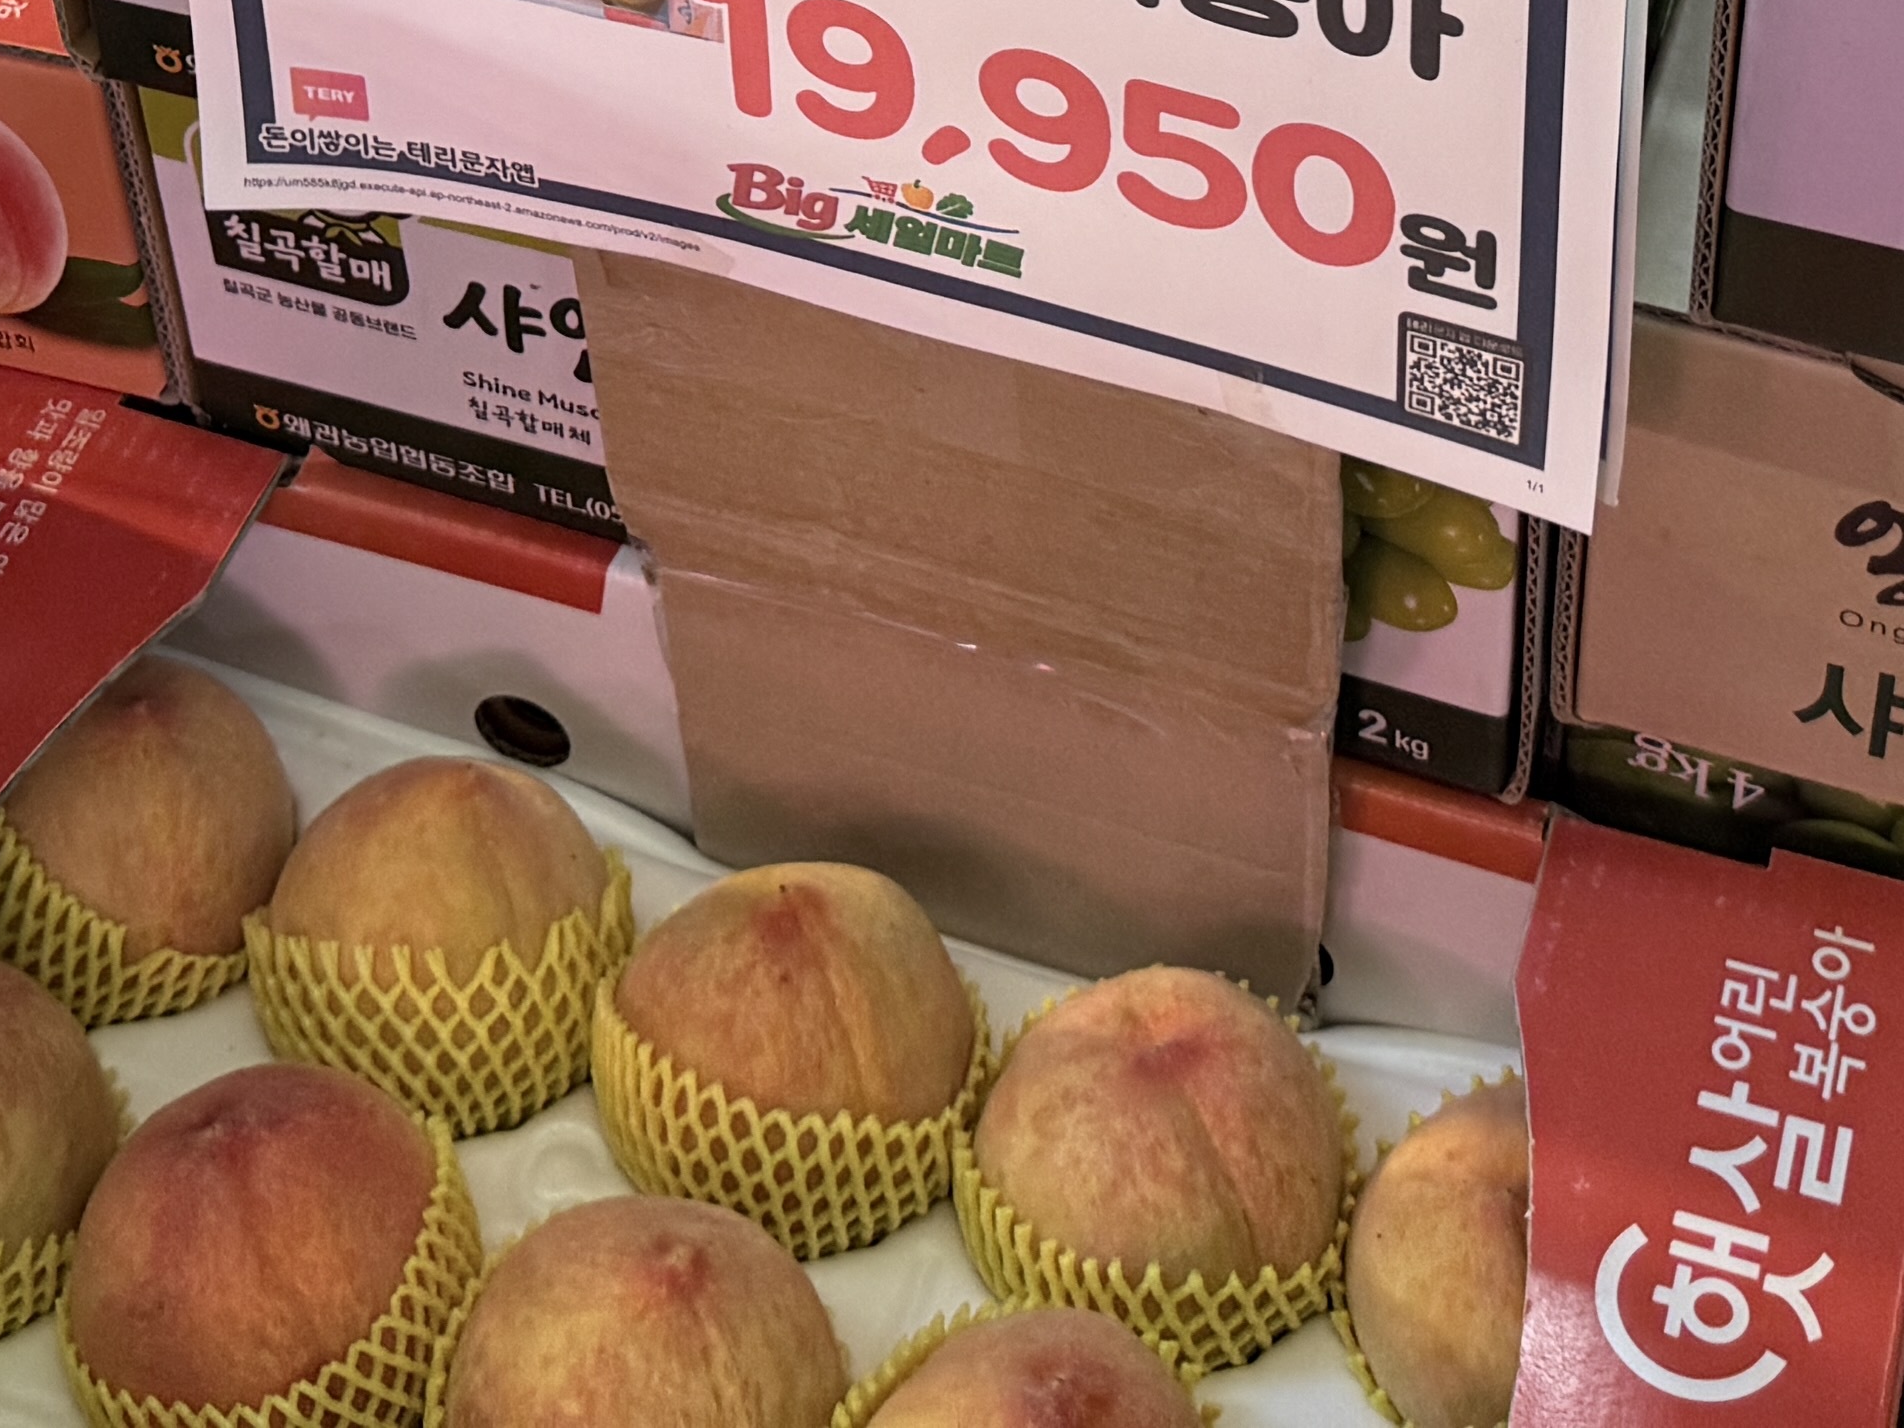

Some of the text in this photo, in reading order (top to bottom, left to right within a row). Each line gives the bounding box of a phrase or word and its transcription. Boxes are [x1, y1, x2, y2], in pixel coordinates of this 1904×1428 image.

[303, 85, 355, 104] TERY
[224, 215, 391, 295] 칠곡할매
[729, 163, 1026, 278] Big 세일마트
[1401, 214, 1497, 311] 원
[463, 371, 532, 403] Shine
[467, 397, 592, 447] 칠곡할매체
[283, 412, 515, 491] 왜관농업협동조합
[1790, 927, 1876, 1100] 복숭아
[1652, 959, 1853, 1343] 햇살 어린
